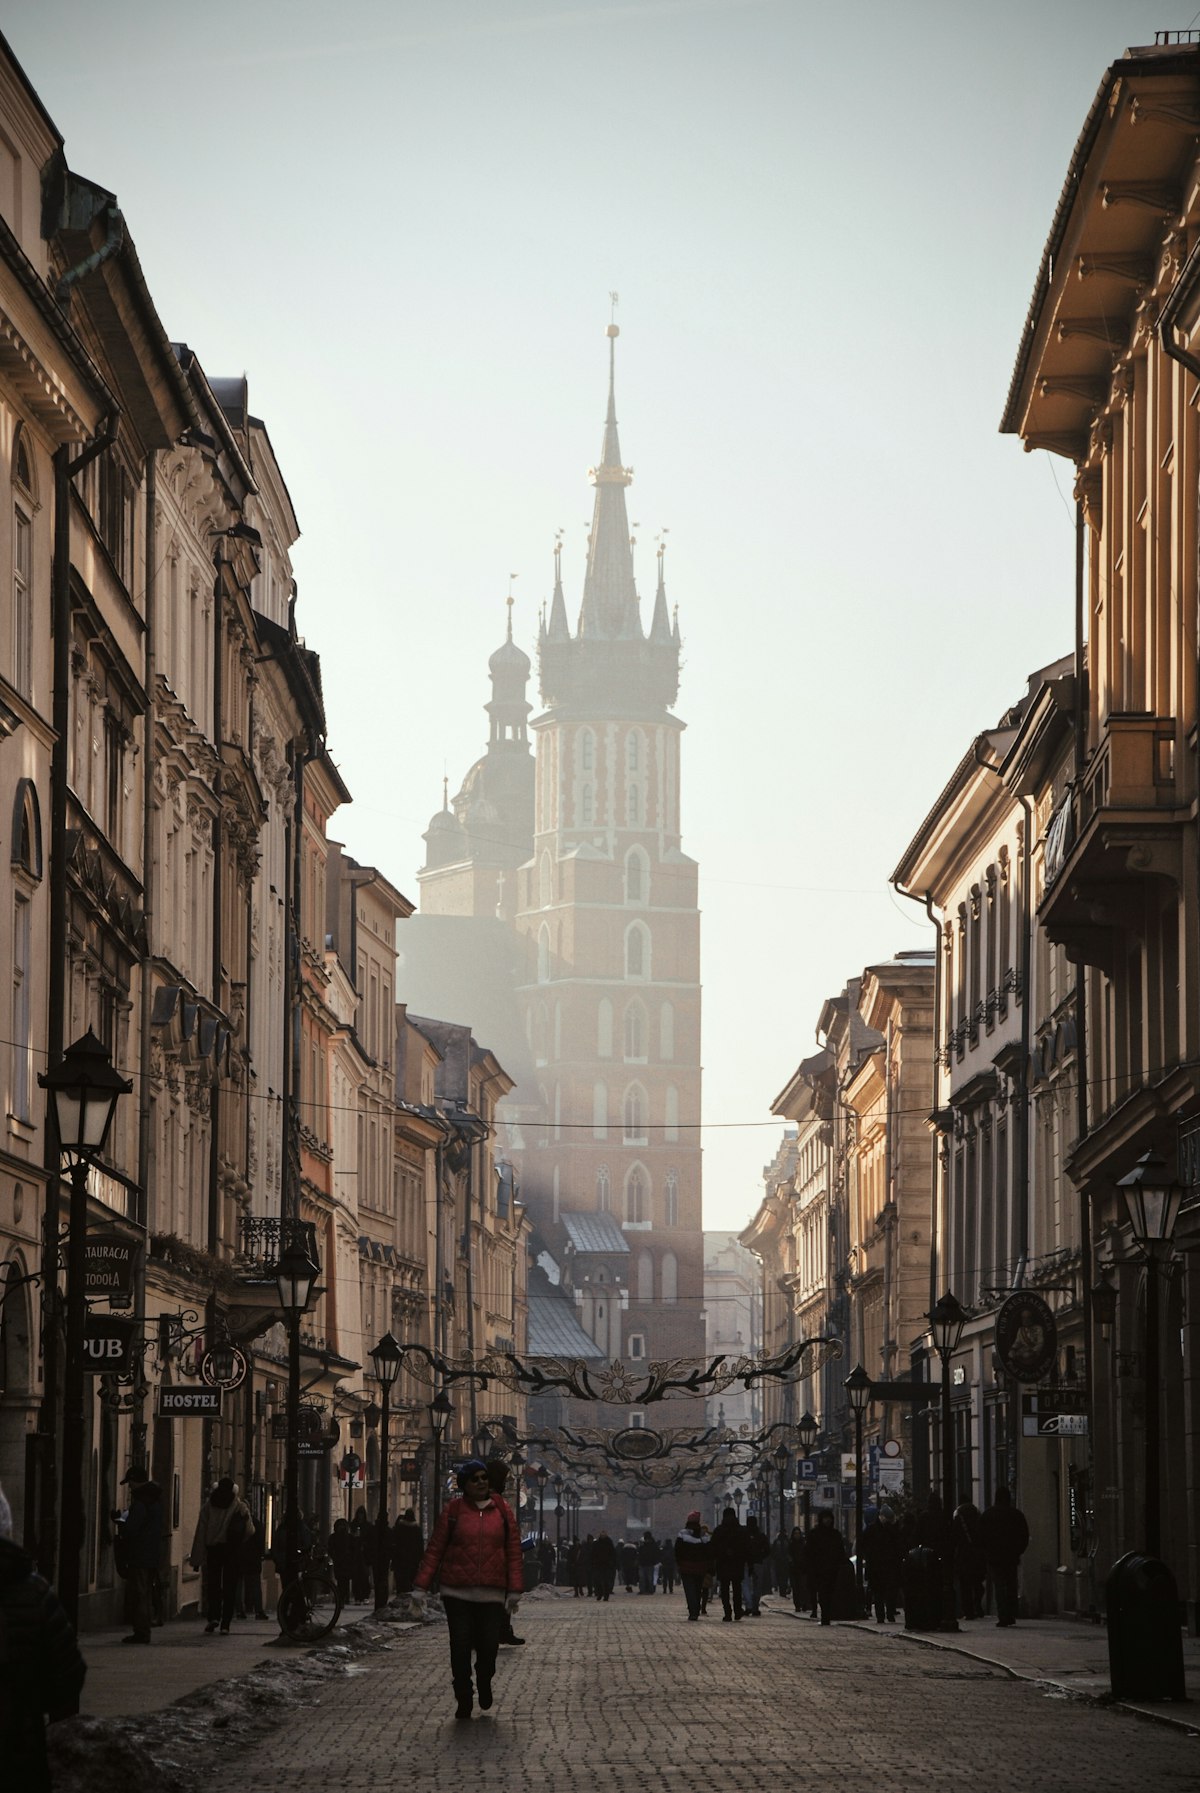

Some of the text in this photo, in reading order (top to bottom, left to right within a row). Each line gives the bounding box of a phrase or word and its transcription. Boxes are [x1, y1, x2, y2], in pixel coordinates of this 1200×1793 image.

[85, 1246, 129, 1261] TAURACJA
[85, 1271, 120, 1287] TODOŁA
[163, 1394, 218, 1408] HOSTEL
[802, 1461, 814, 1478] P
